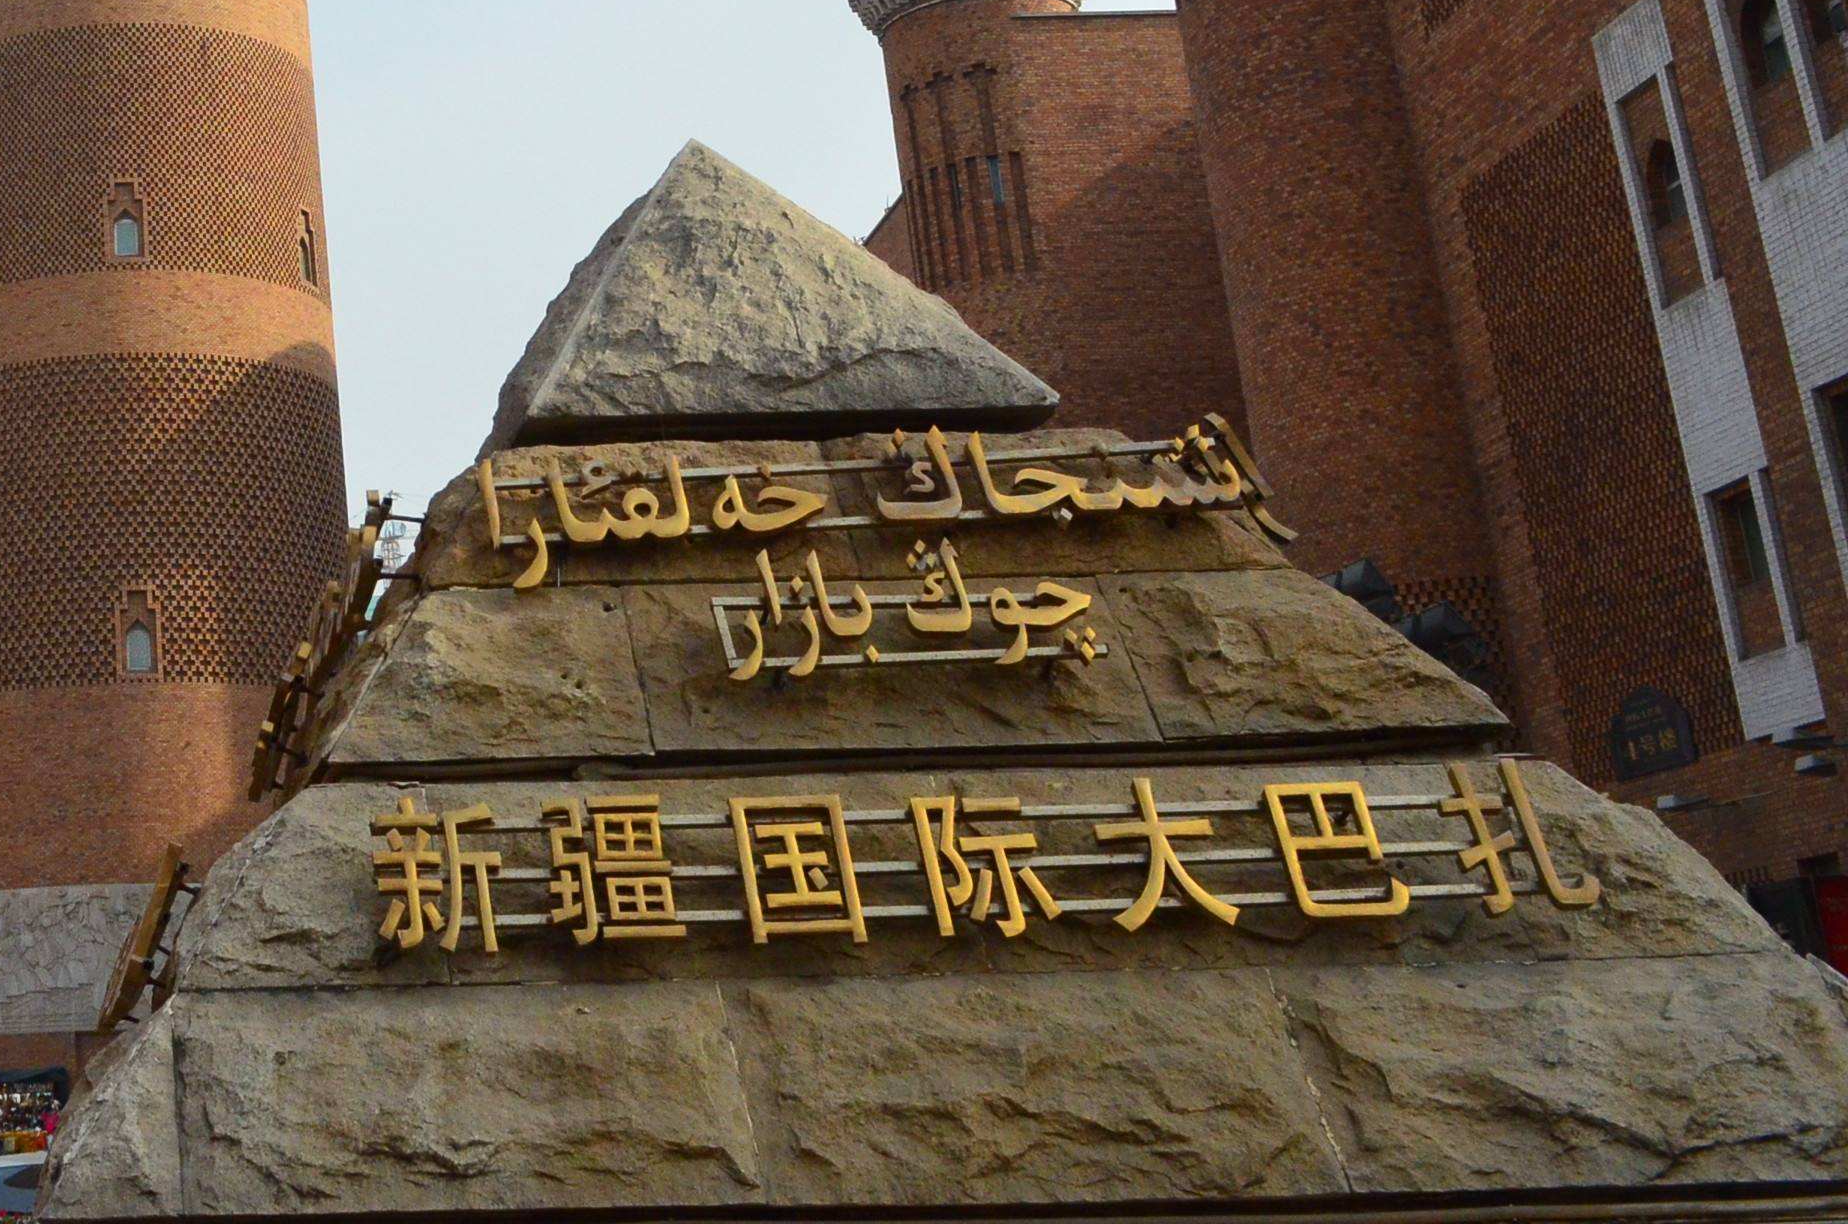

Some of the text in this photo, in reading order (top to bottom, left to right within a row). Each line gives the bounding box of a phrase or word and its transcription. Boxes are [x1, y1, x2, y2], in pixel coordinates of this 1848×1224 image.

[371, 758, 1602, 954] 新疆国际大巴扎
